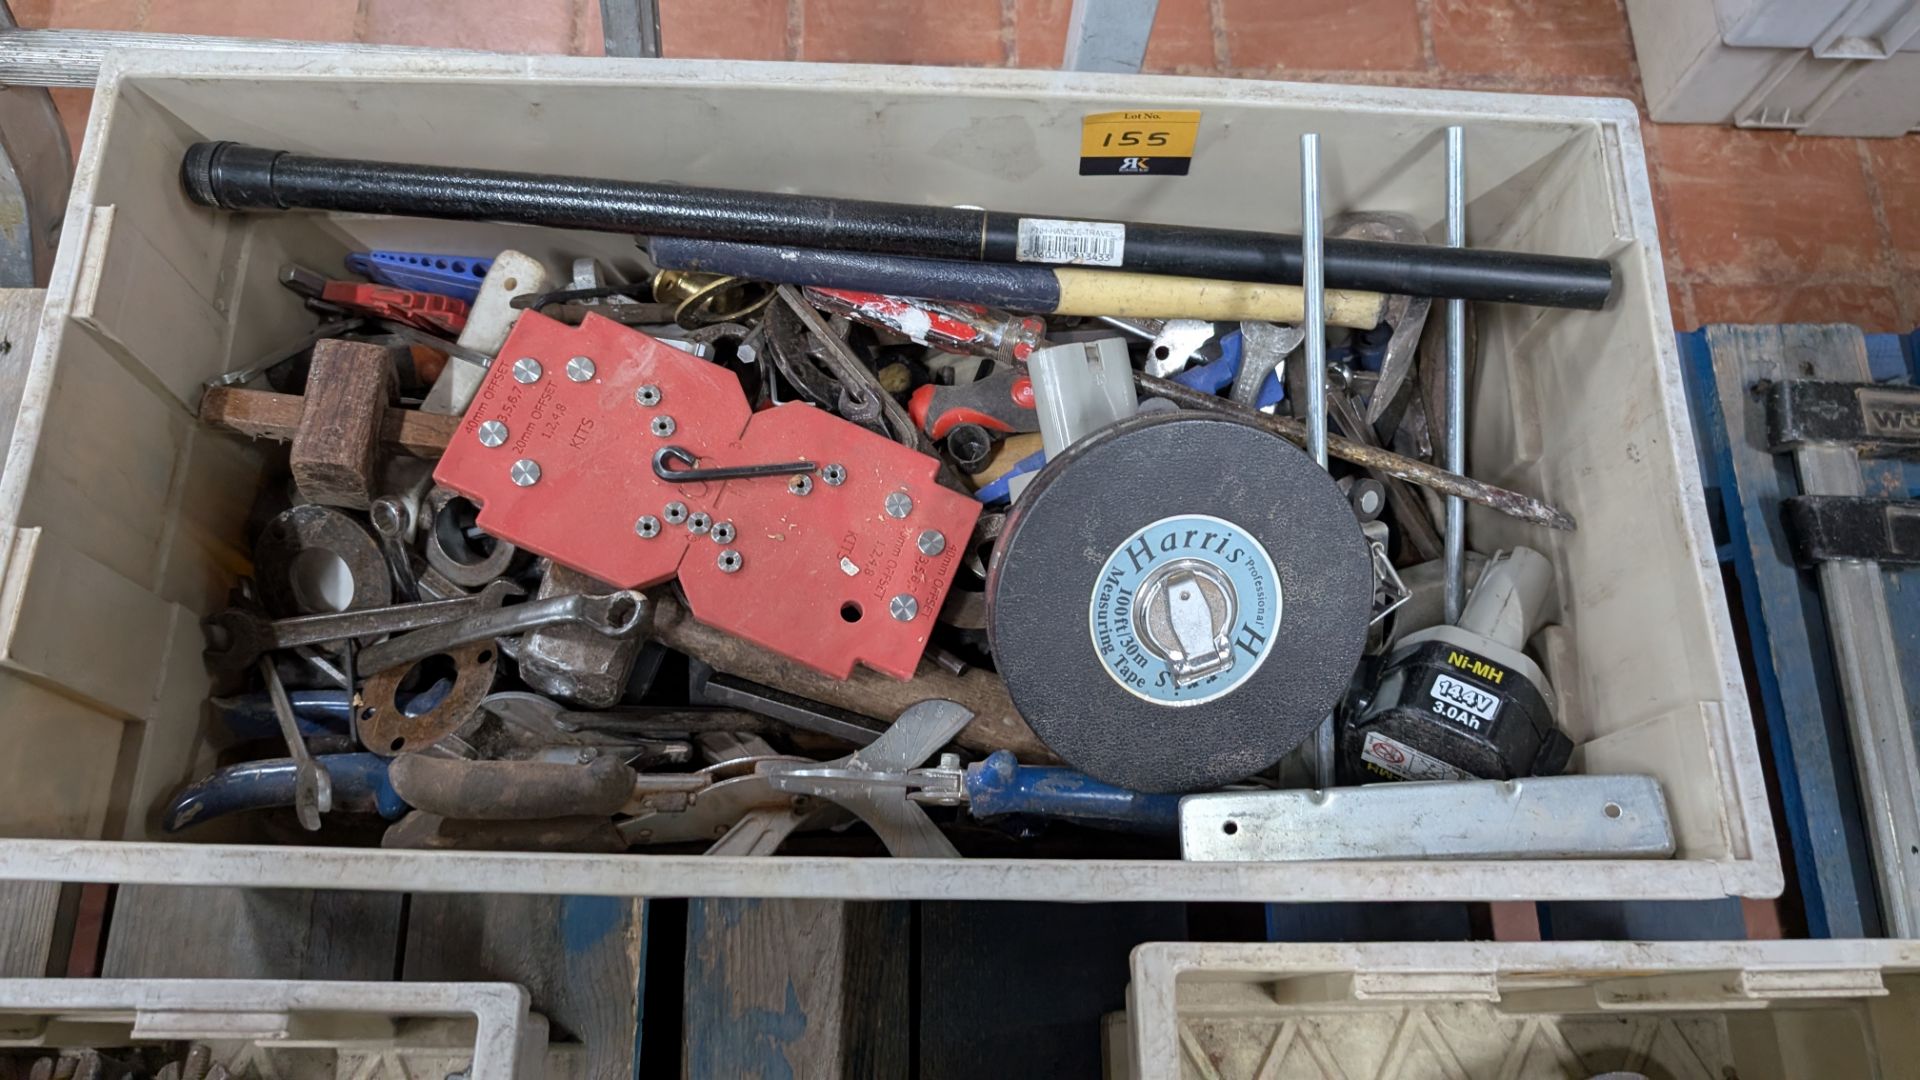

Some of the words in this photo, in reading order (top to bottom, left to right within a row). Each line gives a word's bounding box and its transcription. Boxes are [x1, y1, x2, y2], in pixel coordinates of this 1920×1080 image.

[1124, 112, 1142, 120] Lot
[1144, 112, 1162, 120] No.
[1102, 131, 1170, 147] 155
[465, 402, 488, 434] 40mm
[484, 360, 510, 400] OFFSET
[497, 385, 523, 423] 3,5,6,7
[512, 423, 536, 454] 20mm
[533, 380, 558, 420] OFFSET
[542, 403, 567, 439] 1,2,4,8
[570, 417, 595, 450] KITS
[1125, 530, 1245, 575] Harris
[874, 560, 897, 600] OFFSET
[921, 580, 944, 618] OFFSET
[1098, 566, 1125, 656] Measuring
[1113, 654, 1146, 688] Tape
[1448, 651, 1504, 684] Ni-MH
[1438, 680, 1493, 713] 14.4V
[1432, 701, 1481, 730] 3.0Ah
